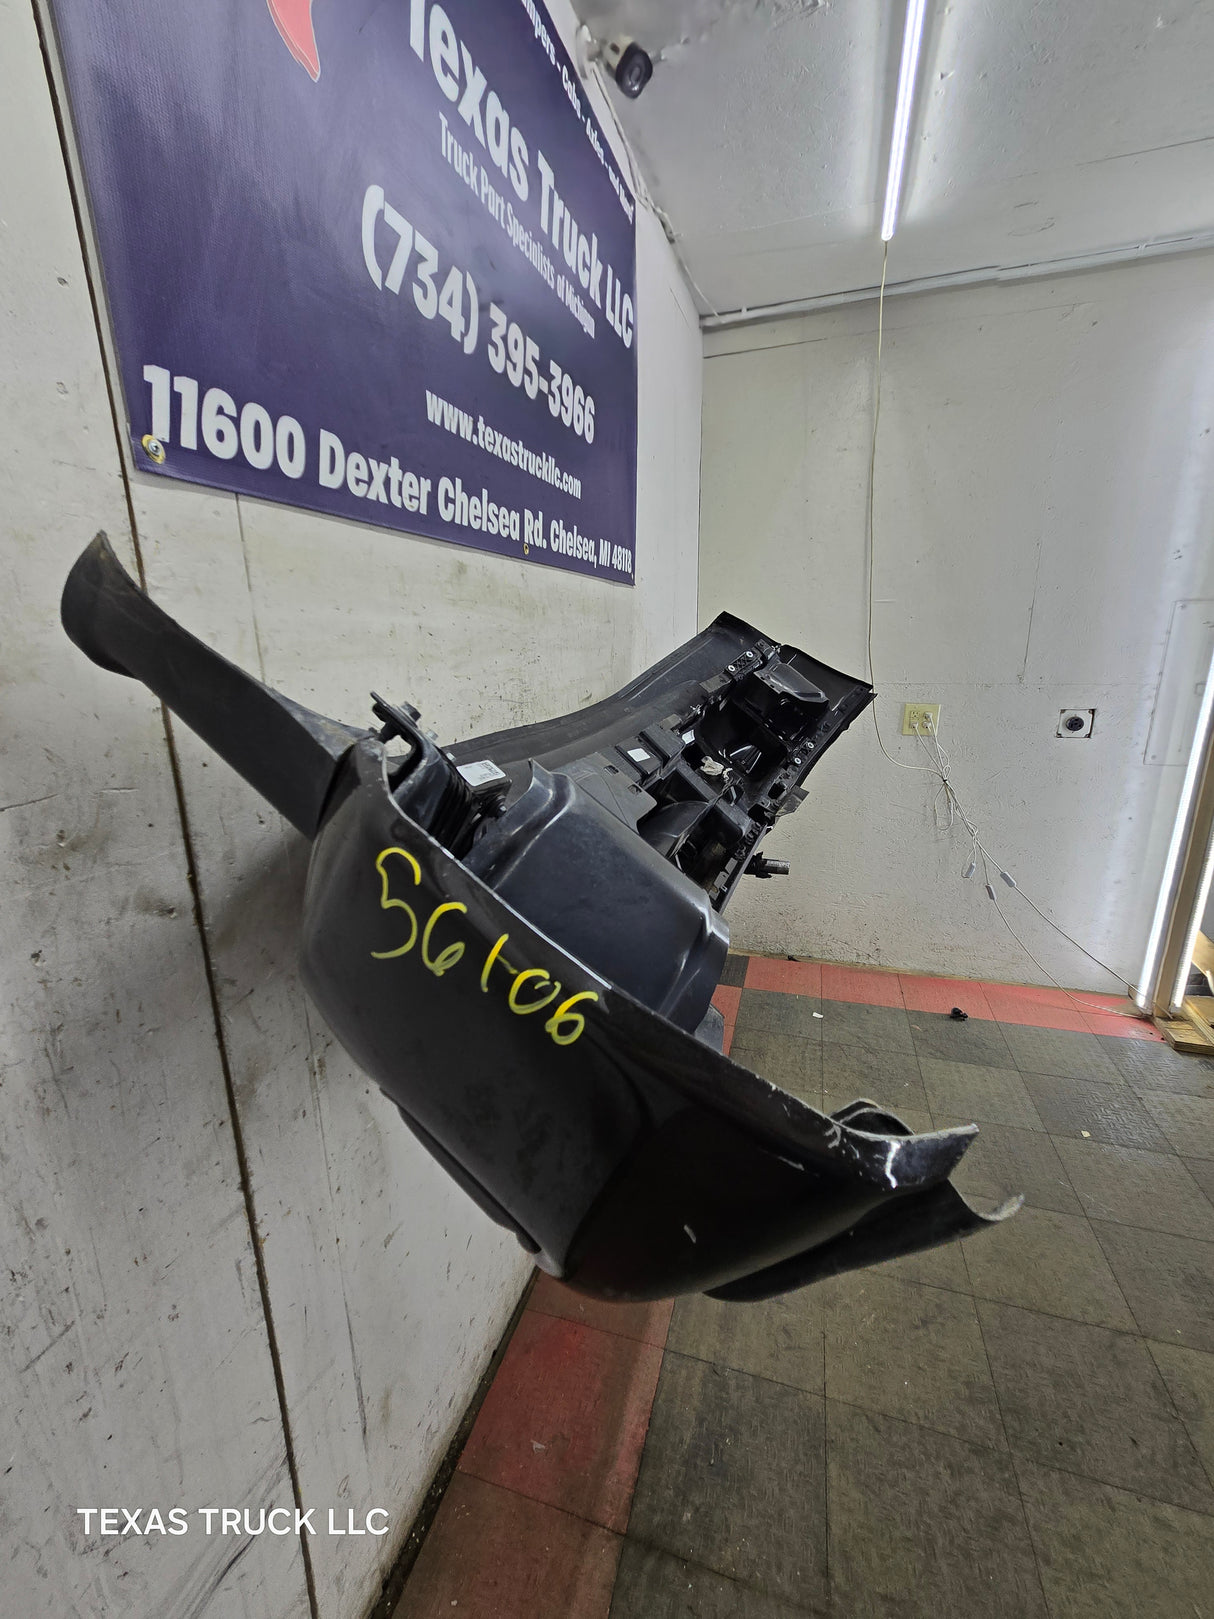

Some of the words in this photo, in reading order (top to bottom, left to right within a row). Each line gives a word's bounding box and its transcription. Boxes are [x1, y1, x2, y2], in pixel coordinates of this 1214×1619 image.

[521, 0, 556, 66] mpers
[439, 111, 479, 197] Truck
[480, 166, 506, 229] Part
[506, 202, 555, 290] Specialists
[556, 274, 565, 304] of
[537, 150, 603, 310] Truck
[606, 264, 634, 349] LLC
[361, 184, 479, 355] (734)
[487, 302, 595, 444] 395-3966
[143, 364, 306, 479] 11600
[318, 428, 431, 515] Dexter
[437, 476, 520, 541] Chelsea
[524, 508, 547, 549] Rd.
[550, 519, 597, 569] Chelsea,
[599, 538, 611, 568] MI
[611, 544, 632, 574] 48118
[425, 389, 582, 499] www.texastruckllc.com
